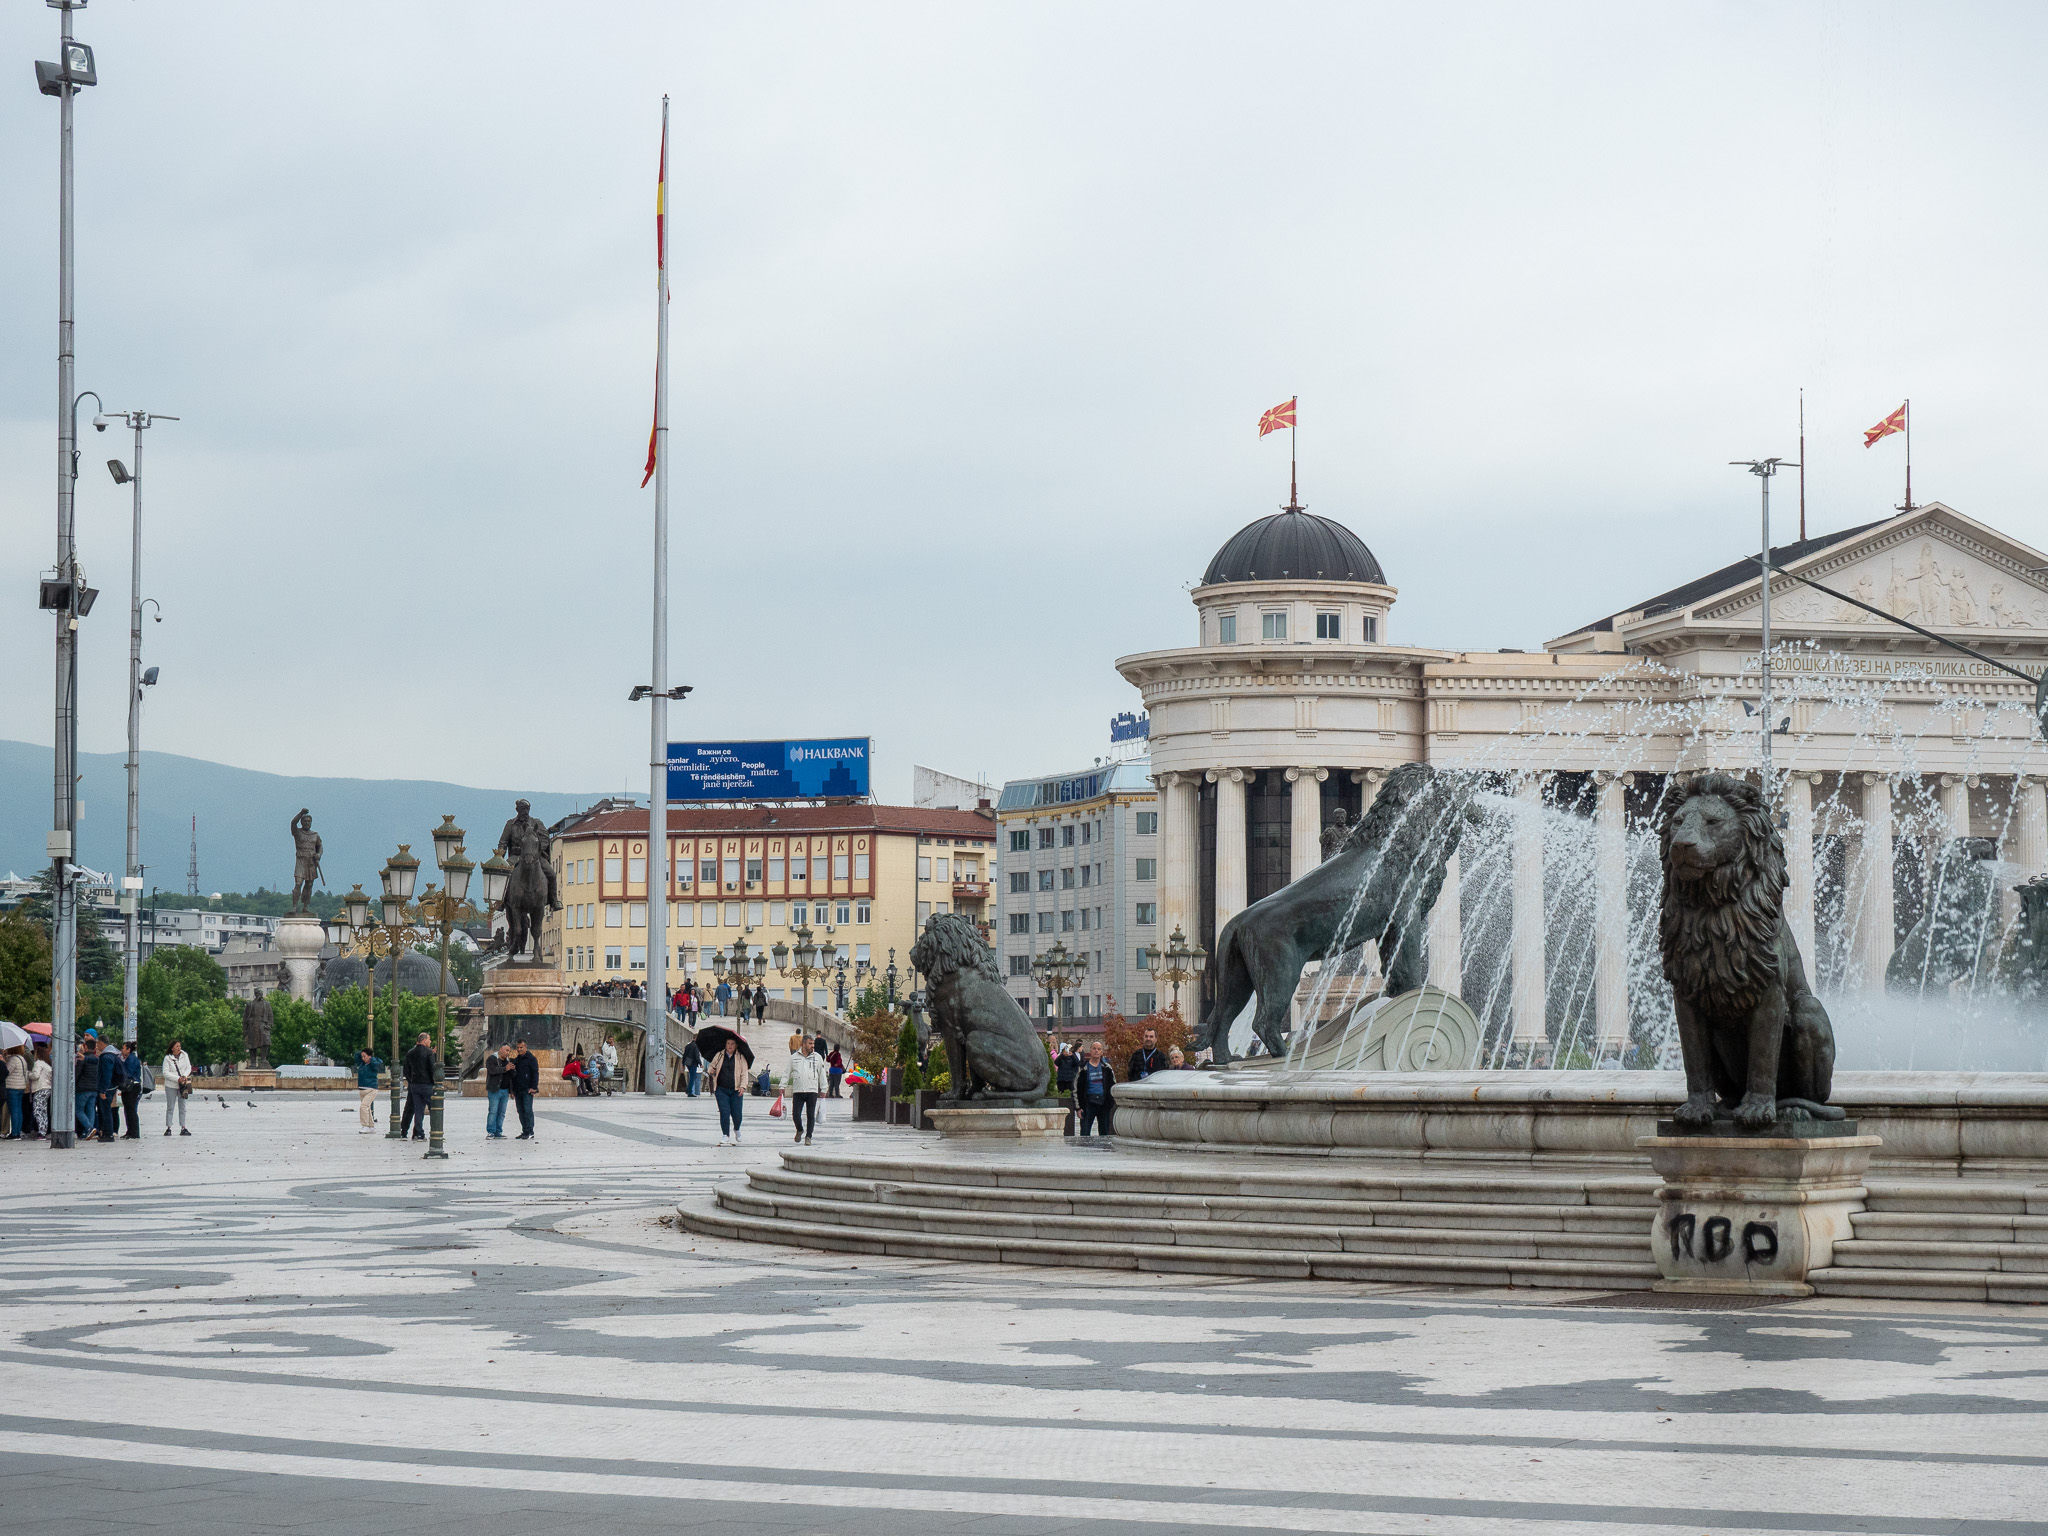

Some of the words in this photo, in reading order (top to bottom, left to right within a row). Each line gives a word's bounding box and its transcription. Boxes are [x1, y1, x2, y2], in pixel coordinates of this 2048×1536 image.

[1746, 656, 1831, 672] АРЕОЛОШКИ
[1874, 660, 1892, 674] НА
[1894, 661, 1968, 676] РЕПУБЛИКА
[697, 748, 721, 756] Важни
[805, 746, 864, 760] HALKBANK
[668, 763, 711, 771] önemlidir.
[702, 780, 721, 790] janë
[722, 780, 755, 790] njerëzit.
[90, 888, 114, 897] HOTEL
